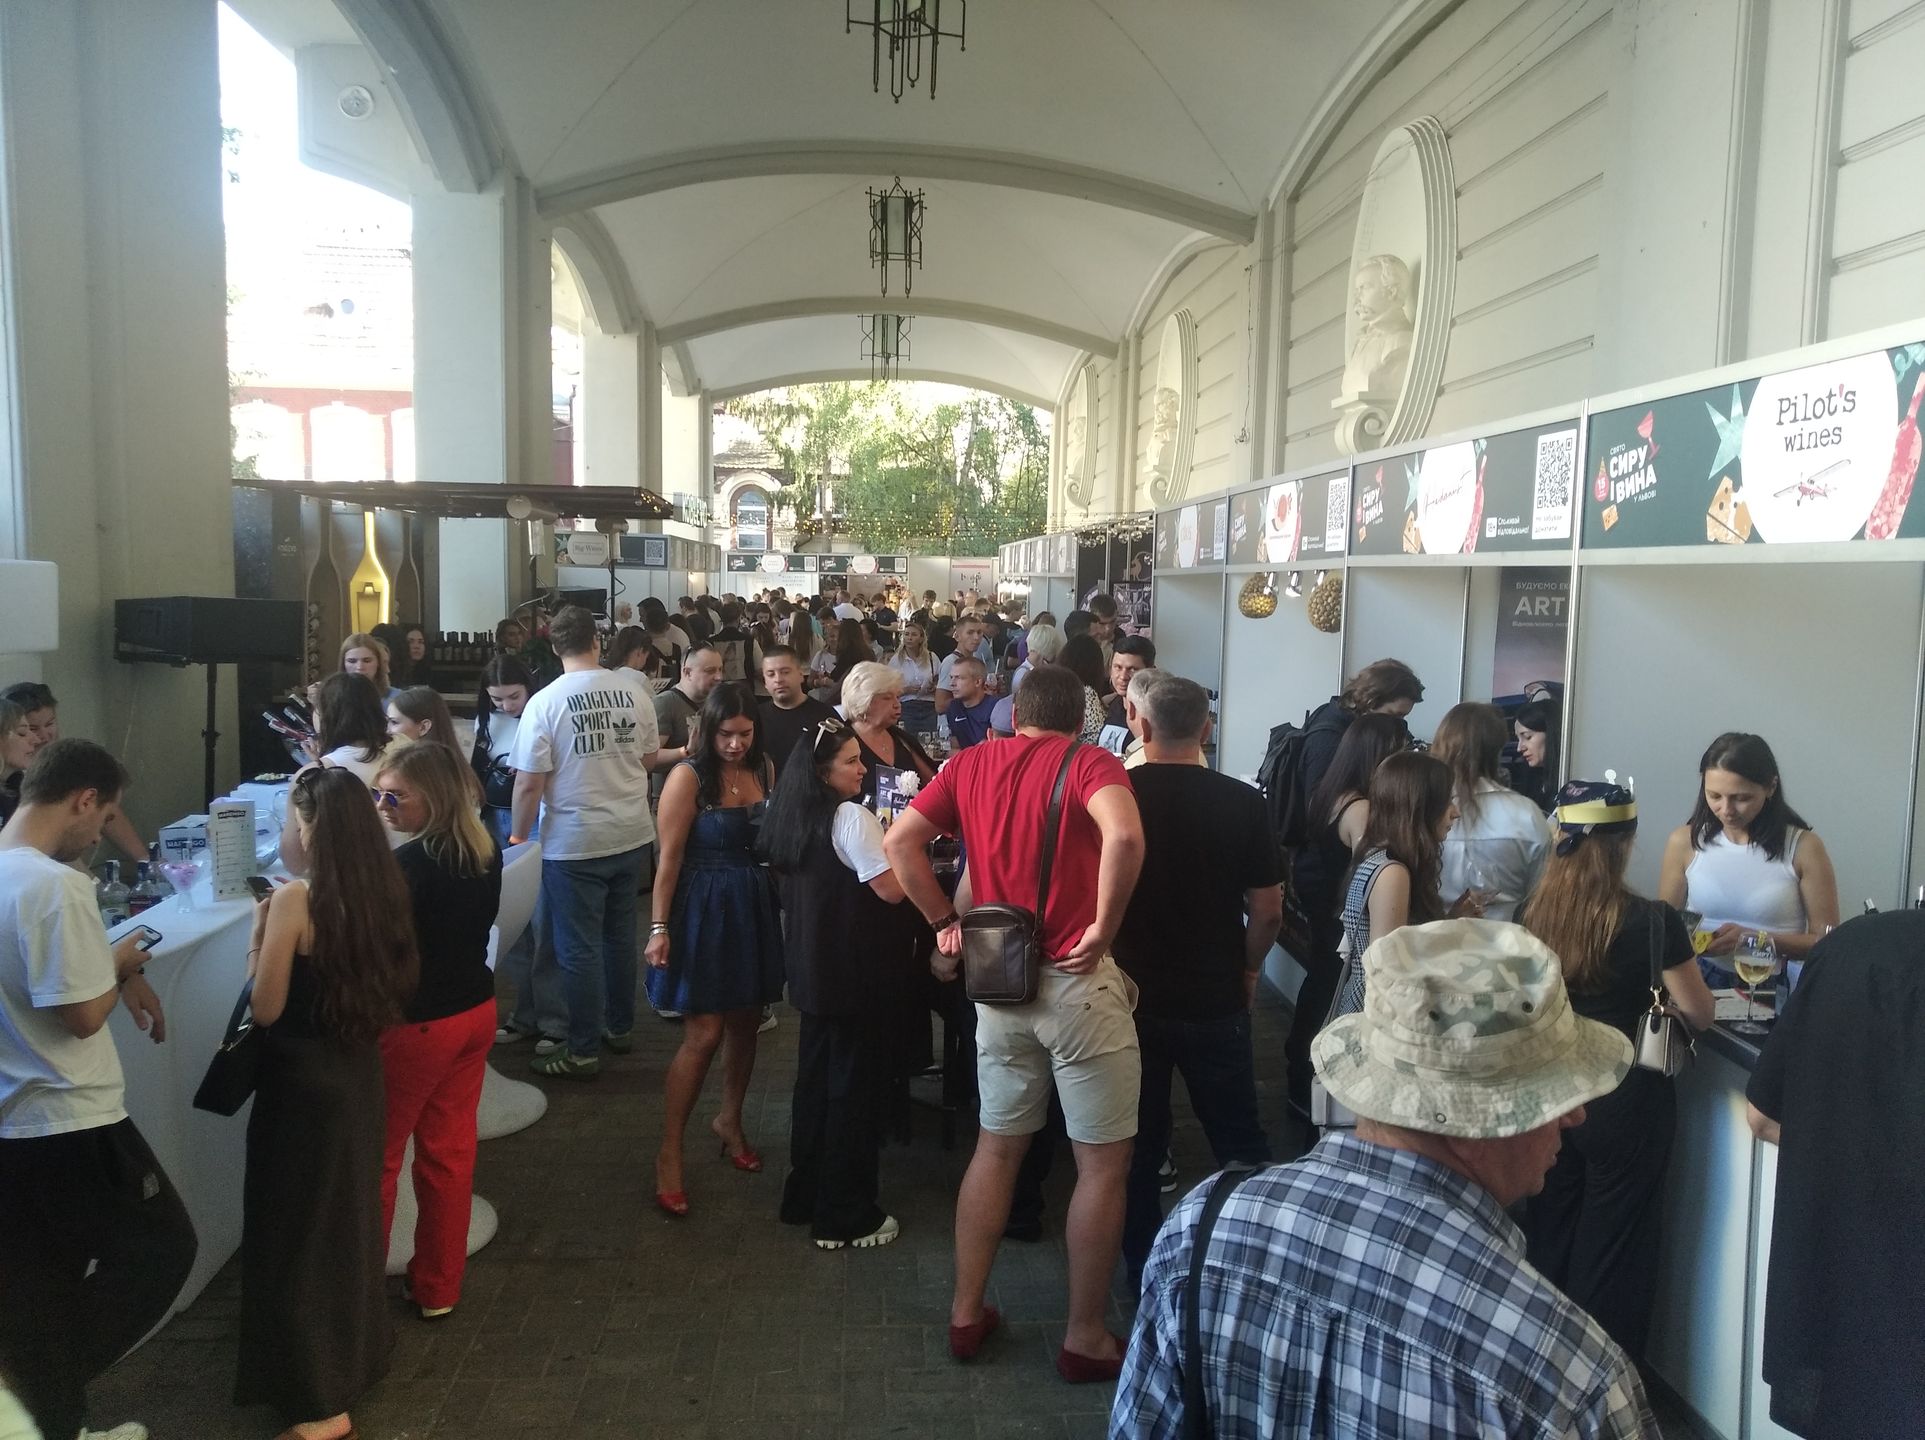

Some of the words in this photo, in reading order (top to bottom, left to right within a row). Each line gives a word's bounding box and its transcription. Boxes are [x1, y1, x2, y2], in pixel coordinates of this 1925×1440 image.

[1776, 383, 1857, 426] Pilot's
[1609, 443, 1626, 456] СВЯТО
[1784, 426, 1842, 452] wines
[1609, 444, 1648, 479] СИРУ
[1615, 463, 1657, 504] ВИНА
[1362, 487, 1380, 509] СИРУ
[1365, 500, 1384, 526] ВИНА
[1516, 581, 1558, 591] БУДУЄМО
[1514, 596, 1566, 616] ART
[567, 690, 634, 713] ORIGINALS
[571, 710, 612, 734] SPORT
[575, 732, 605, 755] CLUB
